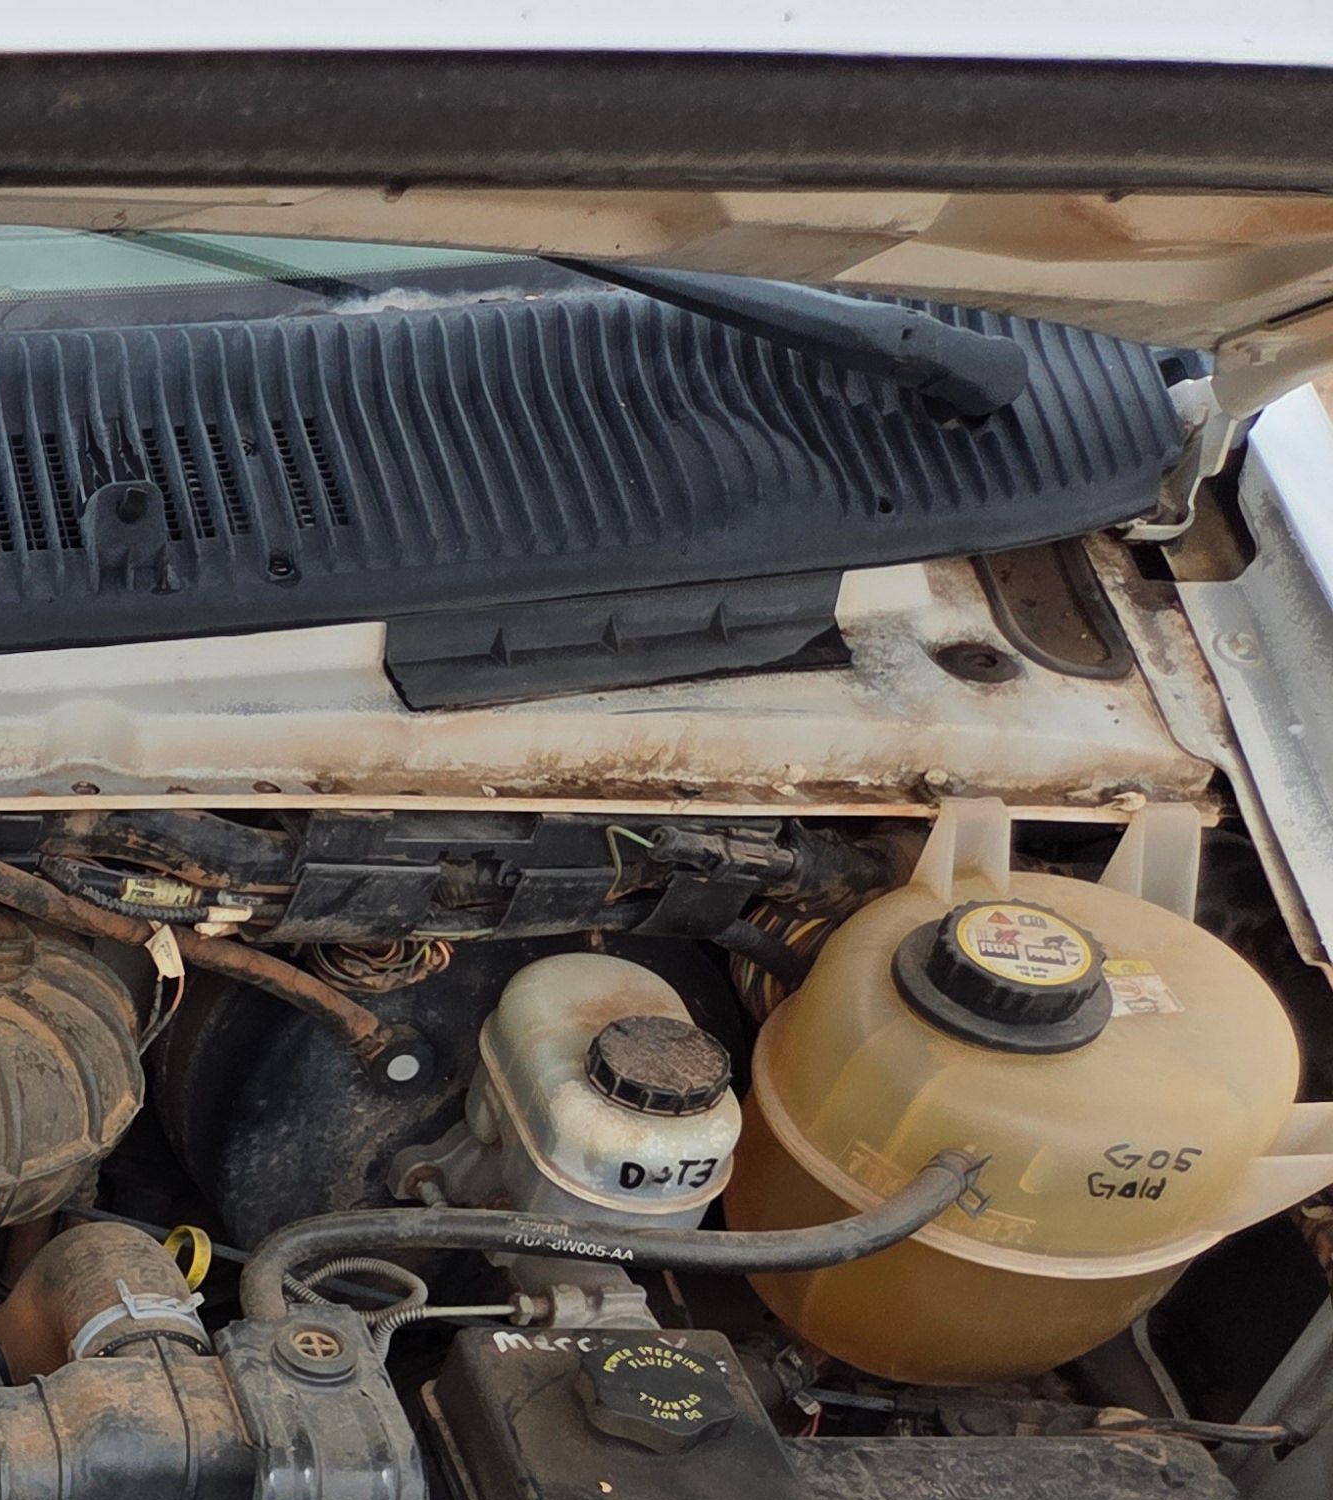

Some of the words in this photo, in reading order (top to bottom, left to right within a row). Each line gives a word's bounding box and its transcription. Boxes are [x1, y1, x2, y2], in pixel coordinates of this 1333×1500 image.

[602, 1347, 635, 1373] POWER
[637, 1345, 706, 1375] STEERING
[627, 1355, 674, 1370] FLUID
[638, 1391, 703, 1411] OVERFILL
[650, 1408, 681, 1421] NOT
[683, 1408, 704, 1422] DO
